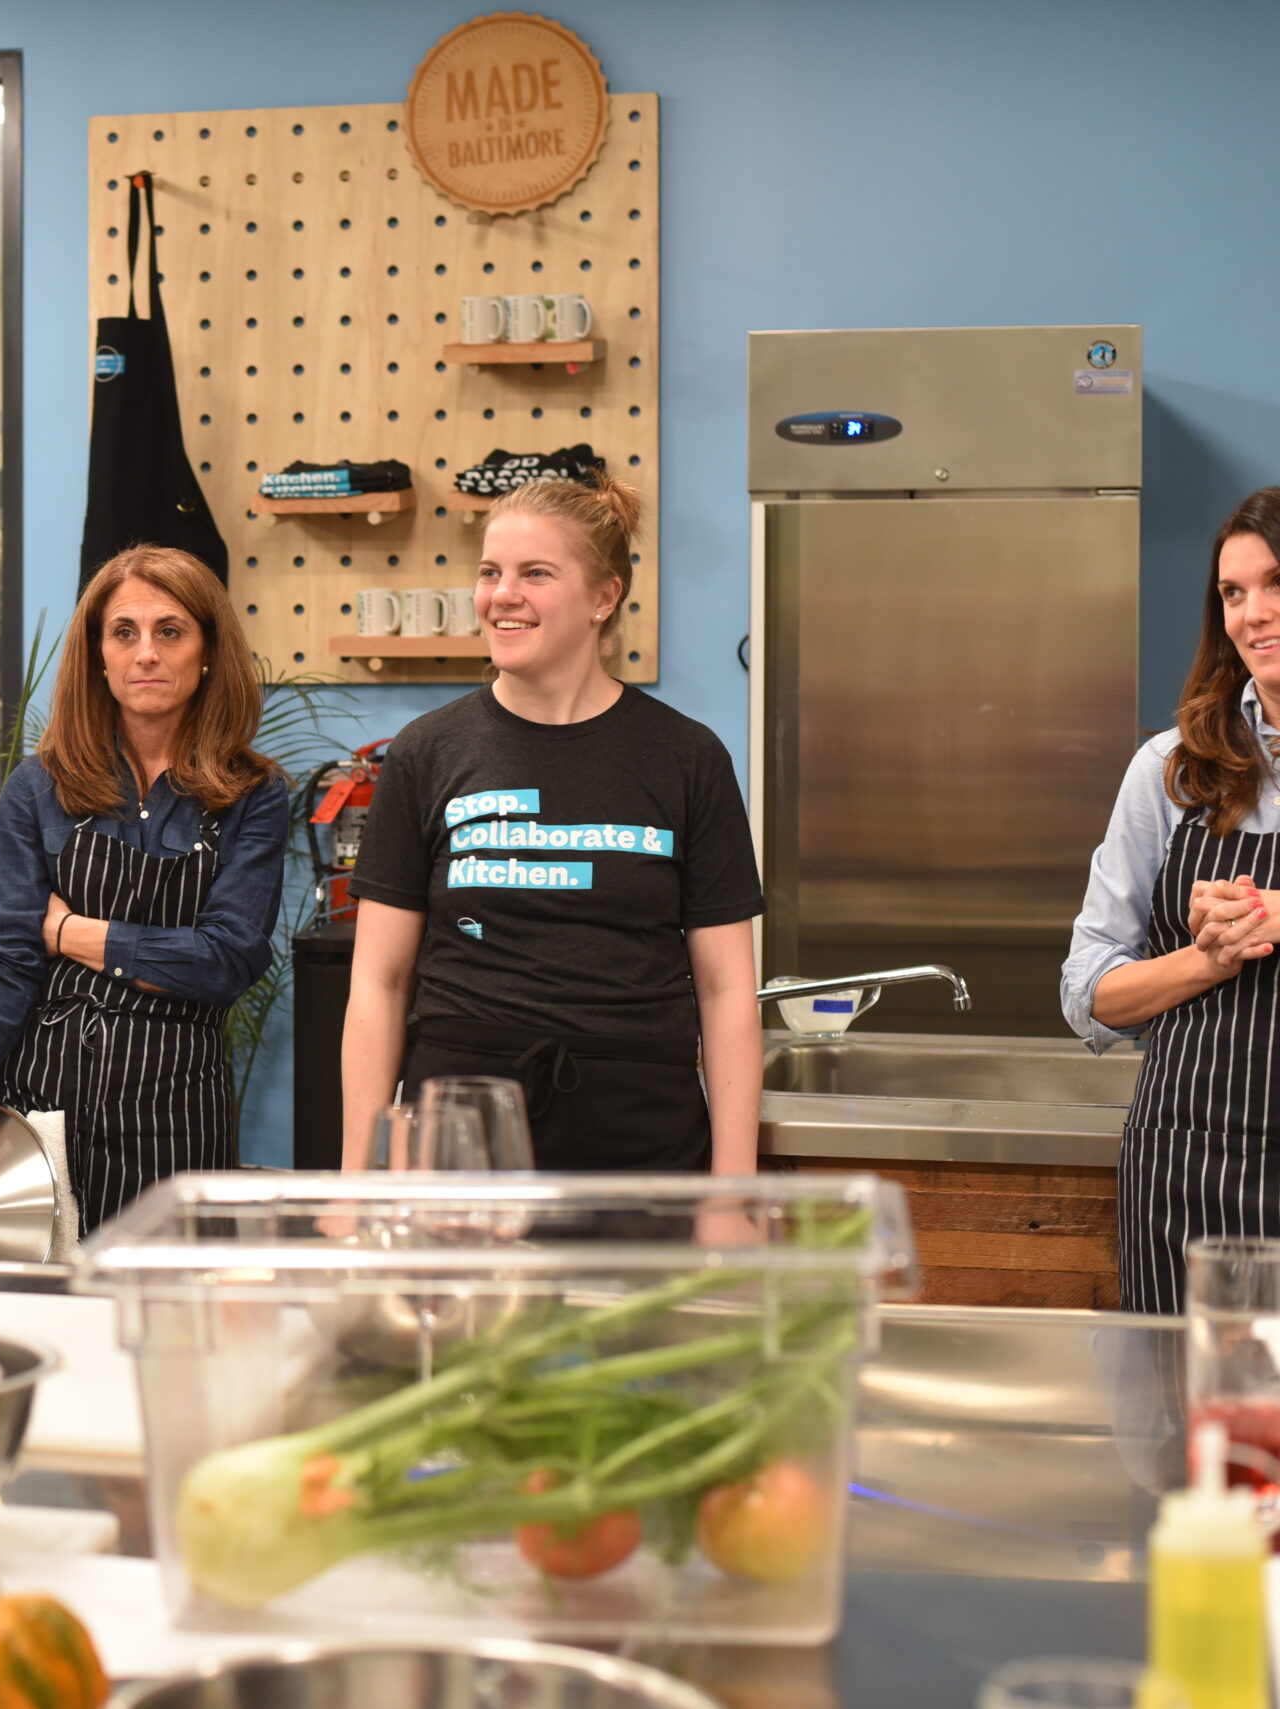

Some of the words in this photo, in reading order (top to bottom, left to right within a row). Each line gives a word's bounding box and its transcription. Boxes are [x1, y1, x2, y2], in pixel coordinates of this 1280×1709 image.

[445, 59, 563, 123] MADE
[498, 118, 512, 133] IN
[447, 127, 567, 169] BALTIMORE
[262, 472, 341, 486] Kitchen.
[445, 794, 528, 823] Stop.
[451, 820, 636, 849] Collaborate
[642, 826, 664, 852] &
[448, 855, 579, 886] Kitchen.
